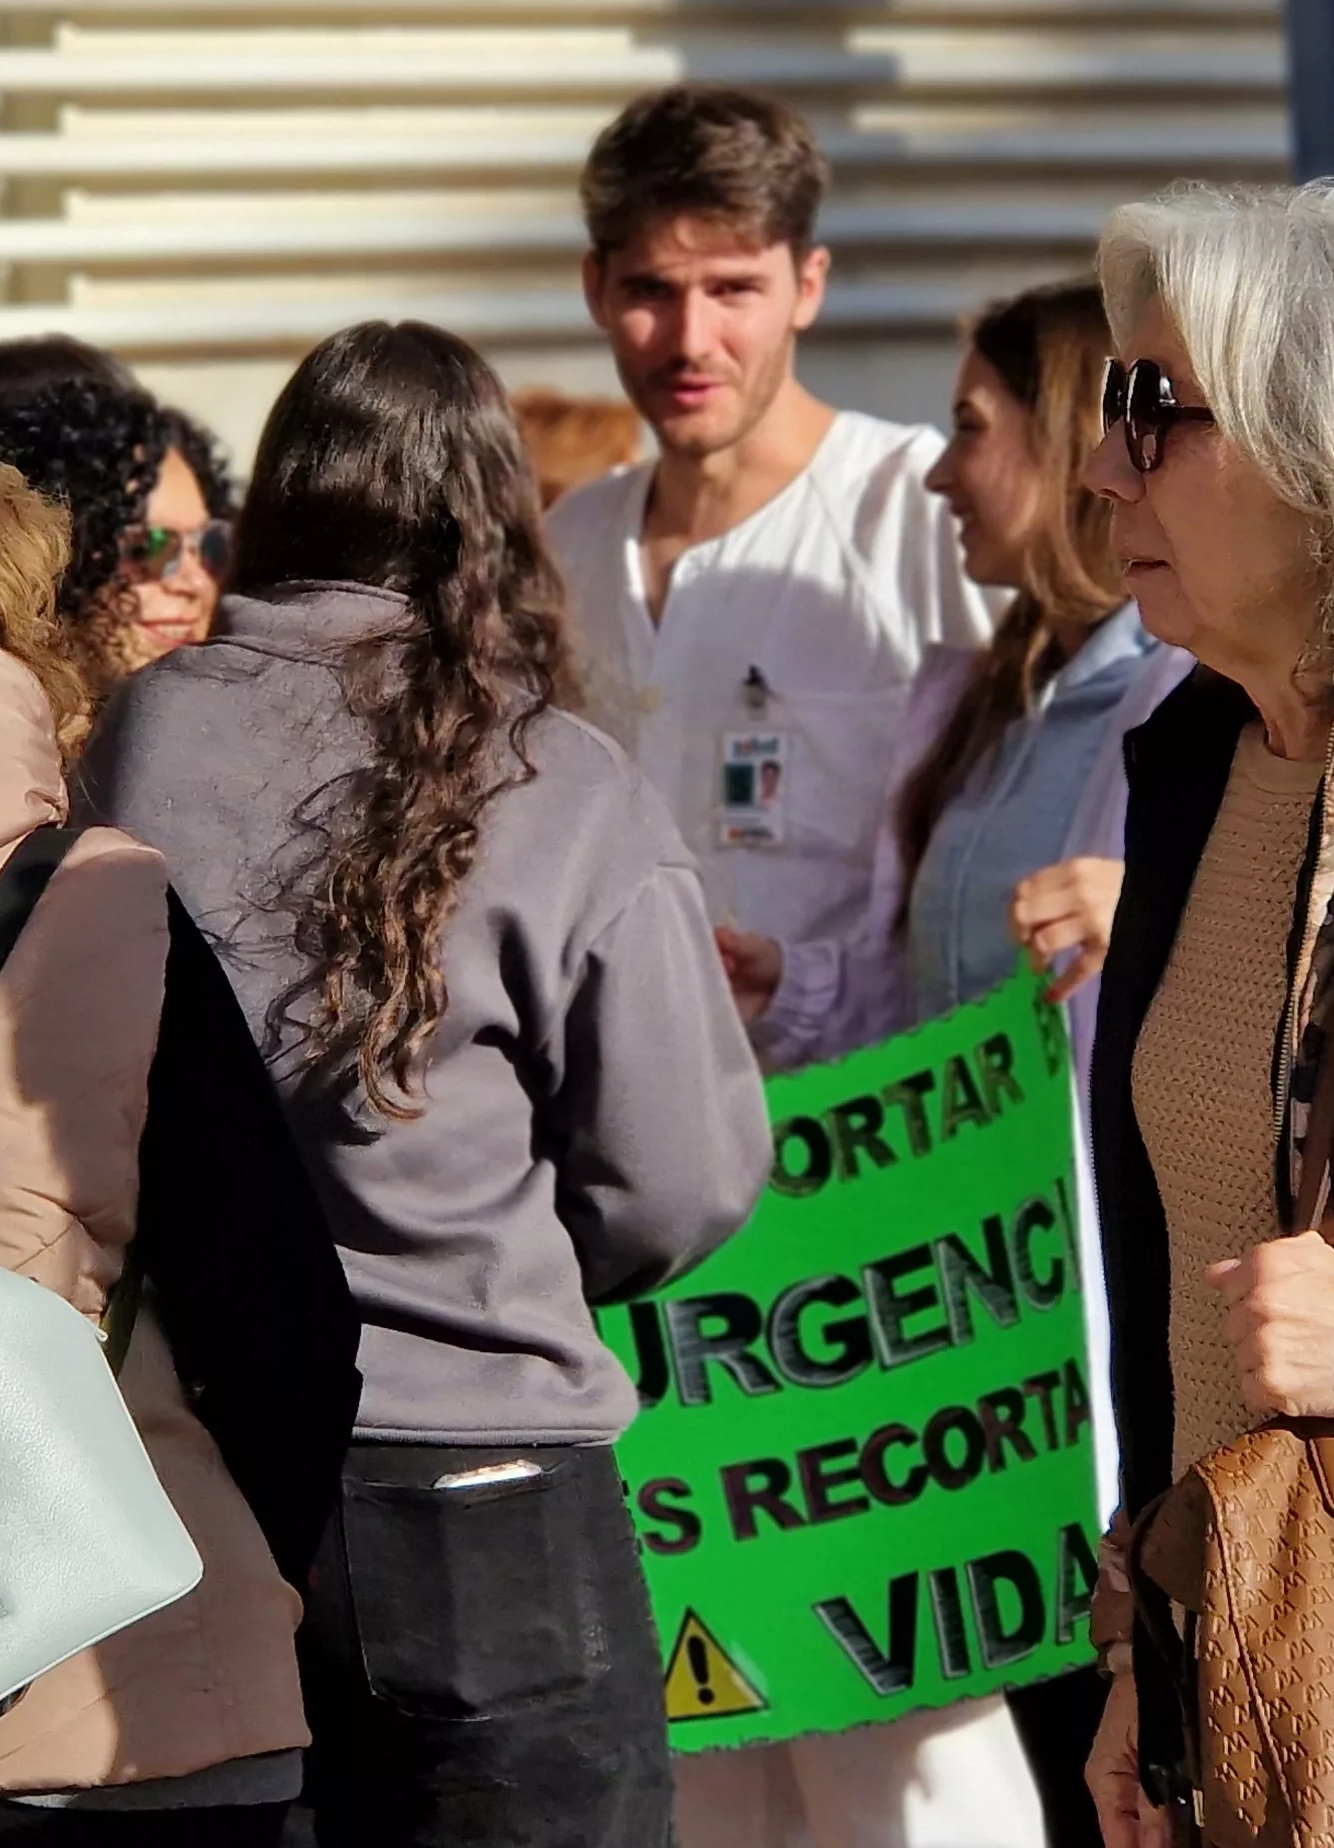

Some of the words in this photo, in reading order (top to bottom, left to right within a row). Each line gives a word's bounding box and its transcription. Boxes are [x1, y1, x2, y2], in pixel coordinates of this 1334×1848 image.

[620, 1477, 703, 1556] S
[719, 1356, 1092, 1543] RECORTA
[812, 1521, 1101, 1698] VIDA
